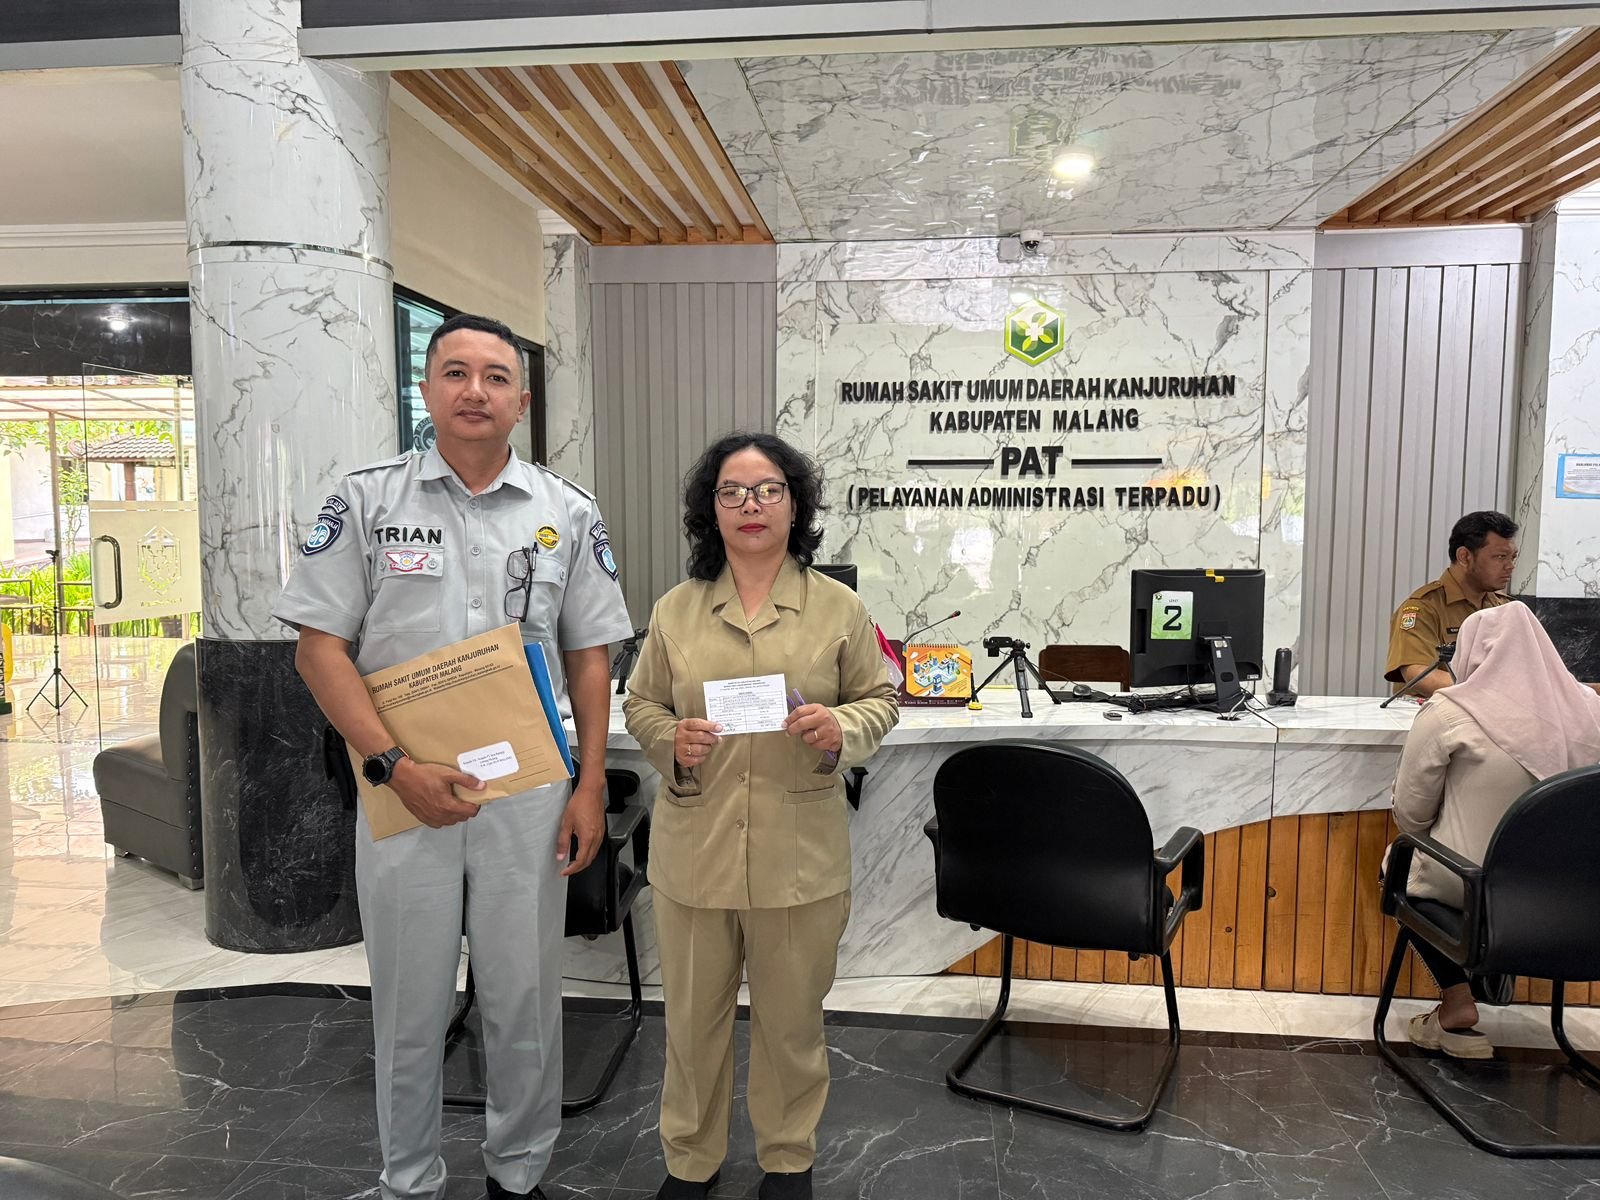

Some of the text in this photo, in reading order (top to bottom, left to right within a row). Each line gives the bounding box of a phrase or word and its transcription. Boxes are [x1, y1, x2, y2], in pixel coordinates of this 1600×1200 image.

[841, 374, 1236, 403] RUMAH SAKIT UMUM DAERAH KANJURUHAN
[929, 408, 1139, 433] KABUPATEN MALANG
[1000, 446, 1064, 478] PAT
[848, 484, 1221, 511] (PELAYANAN ADMINISTRASI TERPADU)
[375, 526, 442, 545] TRIAN
[1162, 605, 1182, 631] 2
[371, 643, 500, 694] RUMAH SAKIT UMUM DAERAH KANJURUHAN
[408, 664, 463, 689] KABUPATEN MALANG
